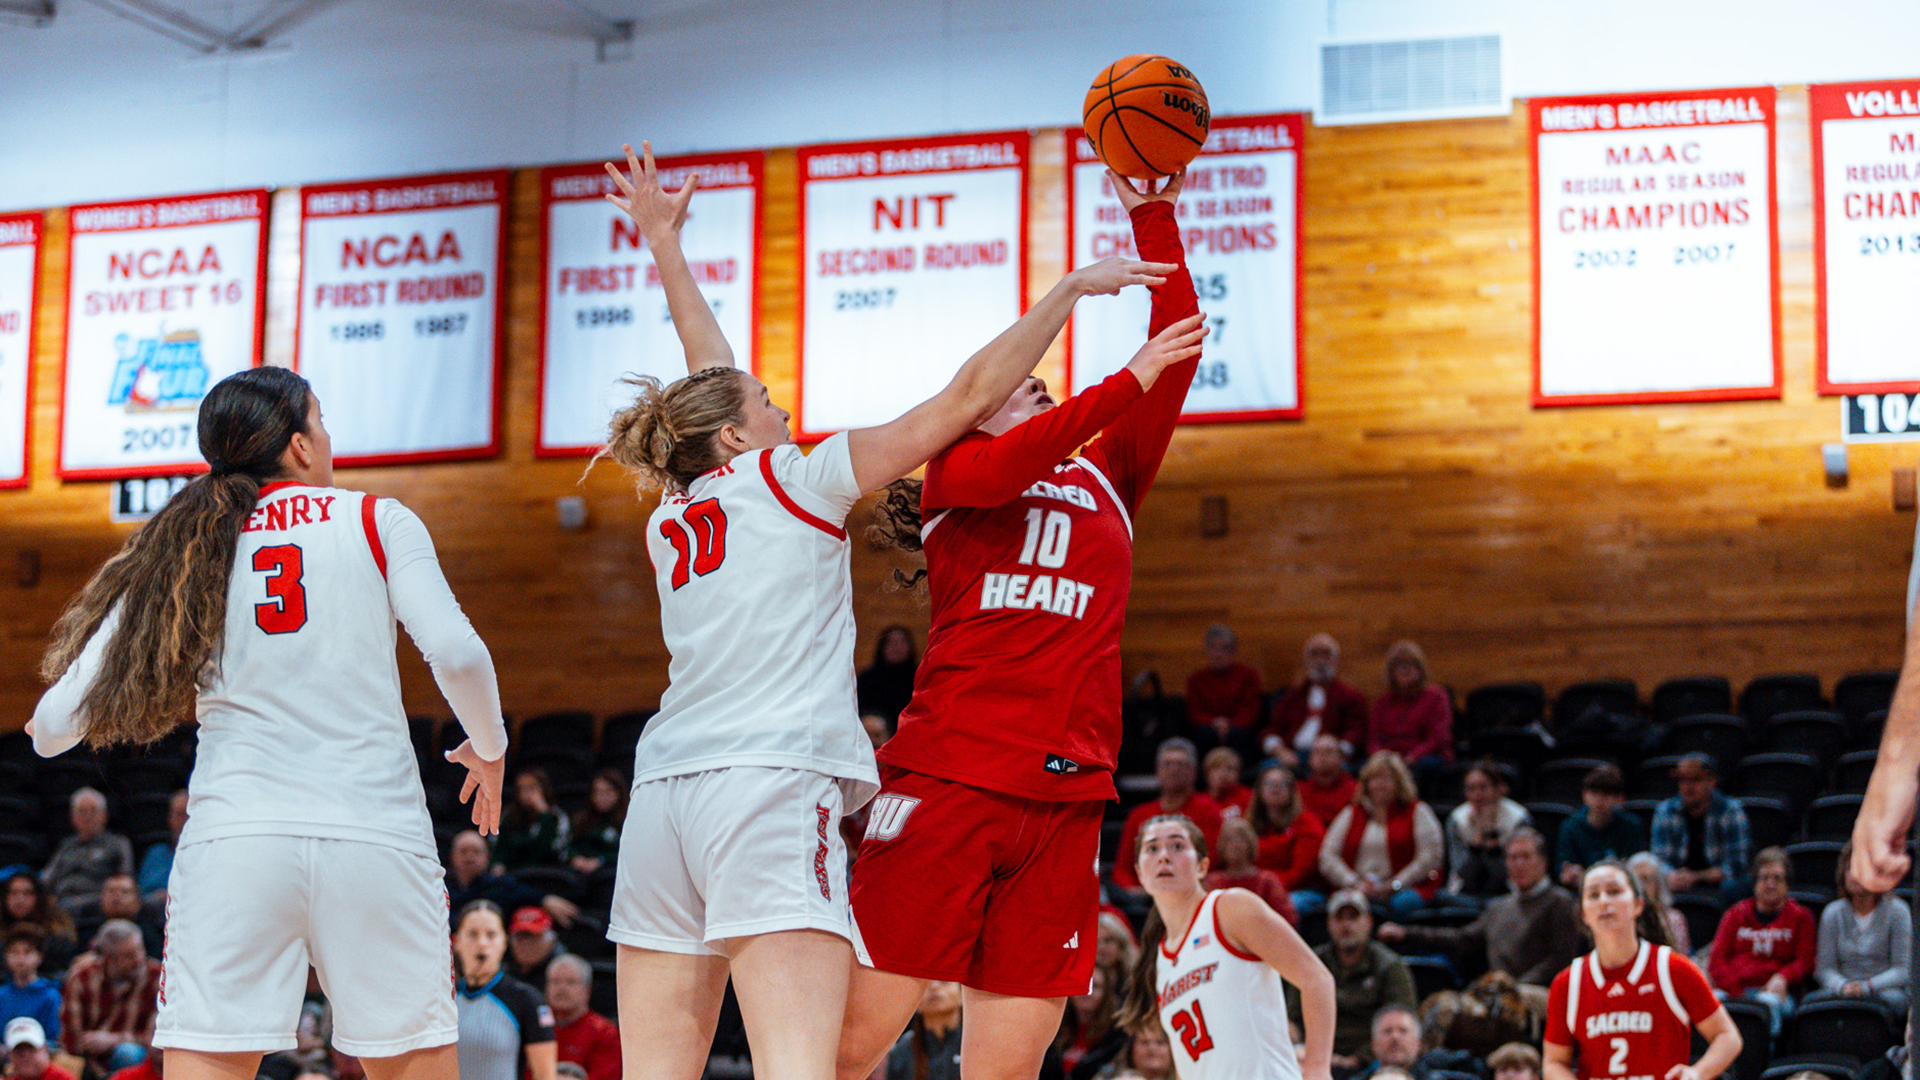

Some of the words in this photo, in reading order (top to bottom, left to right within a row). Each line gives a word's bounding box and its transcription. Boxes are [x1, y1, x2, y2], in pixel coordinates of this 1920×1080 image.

[1163, 92, 1210, 134] ilson
[1541, 104, 1616, 131] MEN'S
[1618, 96, 1766, 127] BASKETBALL
[1845, 89, 1920, 117] VOLL
[807, 151, 879, 178] MEN'S
[880, 142, 1021, 173] BASKETBALL
[1605, 142, 1702, 166] MAAC
[307, 189, 371, 215] MEN'S
[373, 179, 499, 212] BASKETBALL
[1561, 177, 1656, 195] REGULAR
[1666, 171, 1747, 191] SEASON
[73, 203, 156, 232] WOMEN'S
[156, 193, 261, 227] BASKETBALL
[873, 193, 957, 231] NIT
[1196, 196, 1273, 219] SEASON
[1559, 198, 1750, 233] CHAMPIONS
[108, 244, 221, 281] NCAA
[342, 229, 462, 269] NCAA
[818, 245, 916, 277] SECOND
[924, 238, 1008, 270] ROUND
[1575, 248, 1637, 269] 2002
[1674, 242, 1735, 264] 2007
[84, 284, 199, 315] SWEET
[210, 279, 243, 304] 16
[315, 280, 388, 308] FIRST
[397, 270, 486, 304] ROUND
[558, 264, 635, 295] FIRST
[835, 286, 897, 311] 2007
[123, 424, 191, 452] 2007
[241, 494, 336, 533] ENRY
[1021, 480, 1098, 511] CRED
[658, 496, 727, 592] 10
[1018, 507, 1071, 569] 10
[252, 542, 308, 635] 3
[979, 572, 1095, 620] HEART
[1170, 998, 1214, 1062] 21
[1586, 1010, 1653, 1039] SACRED
[1607, 1037, 1629, 1075] 2
